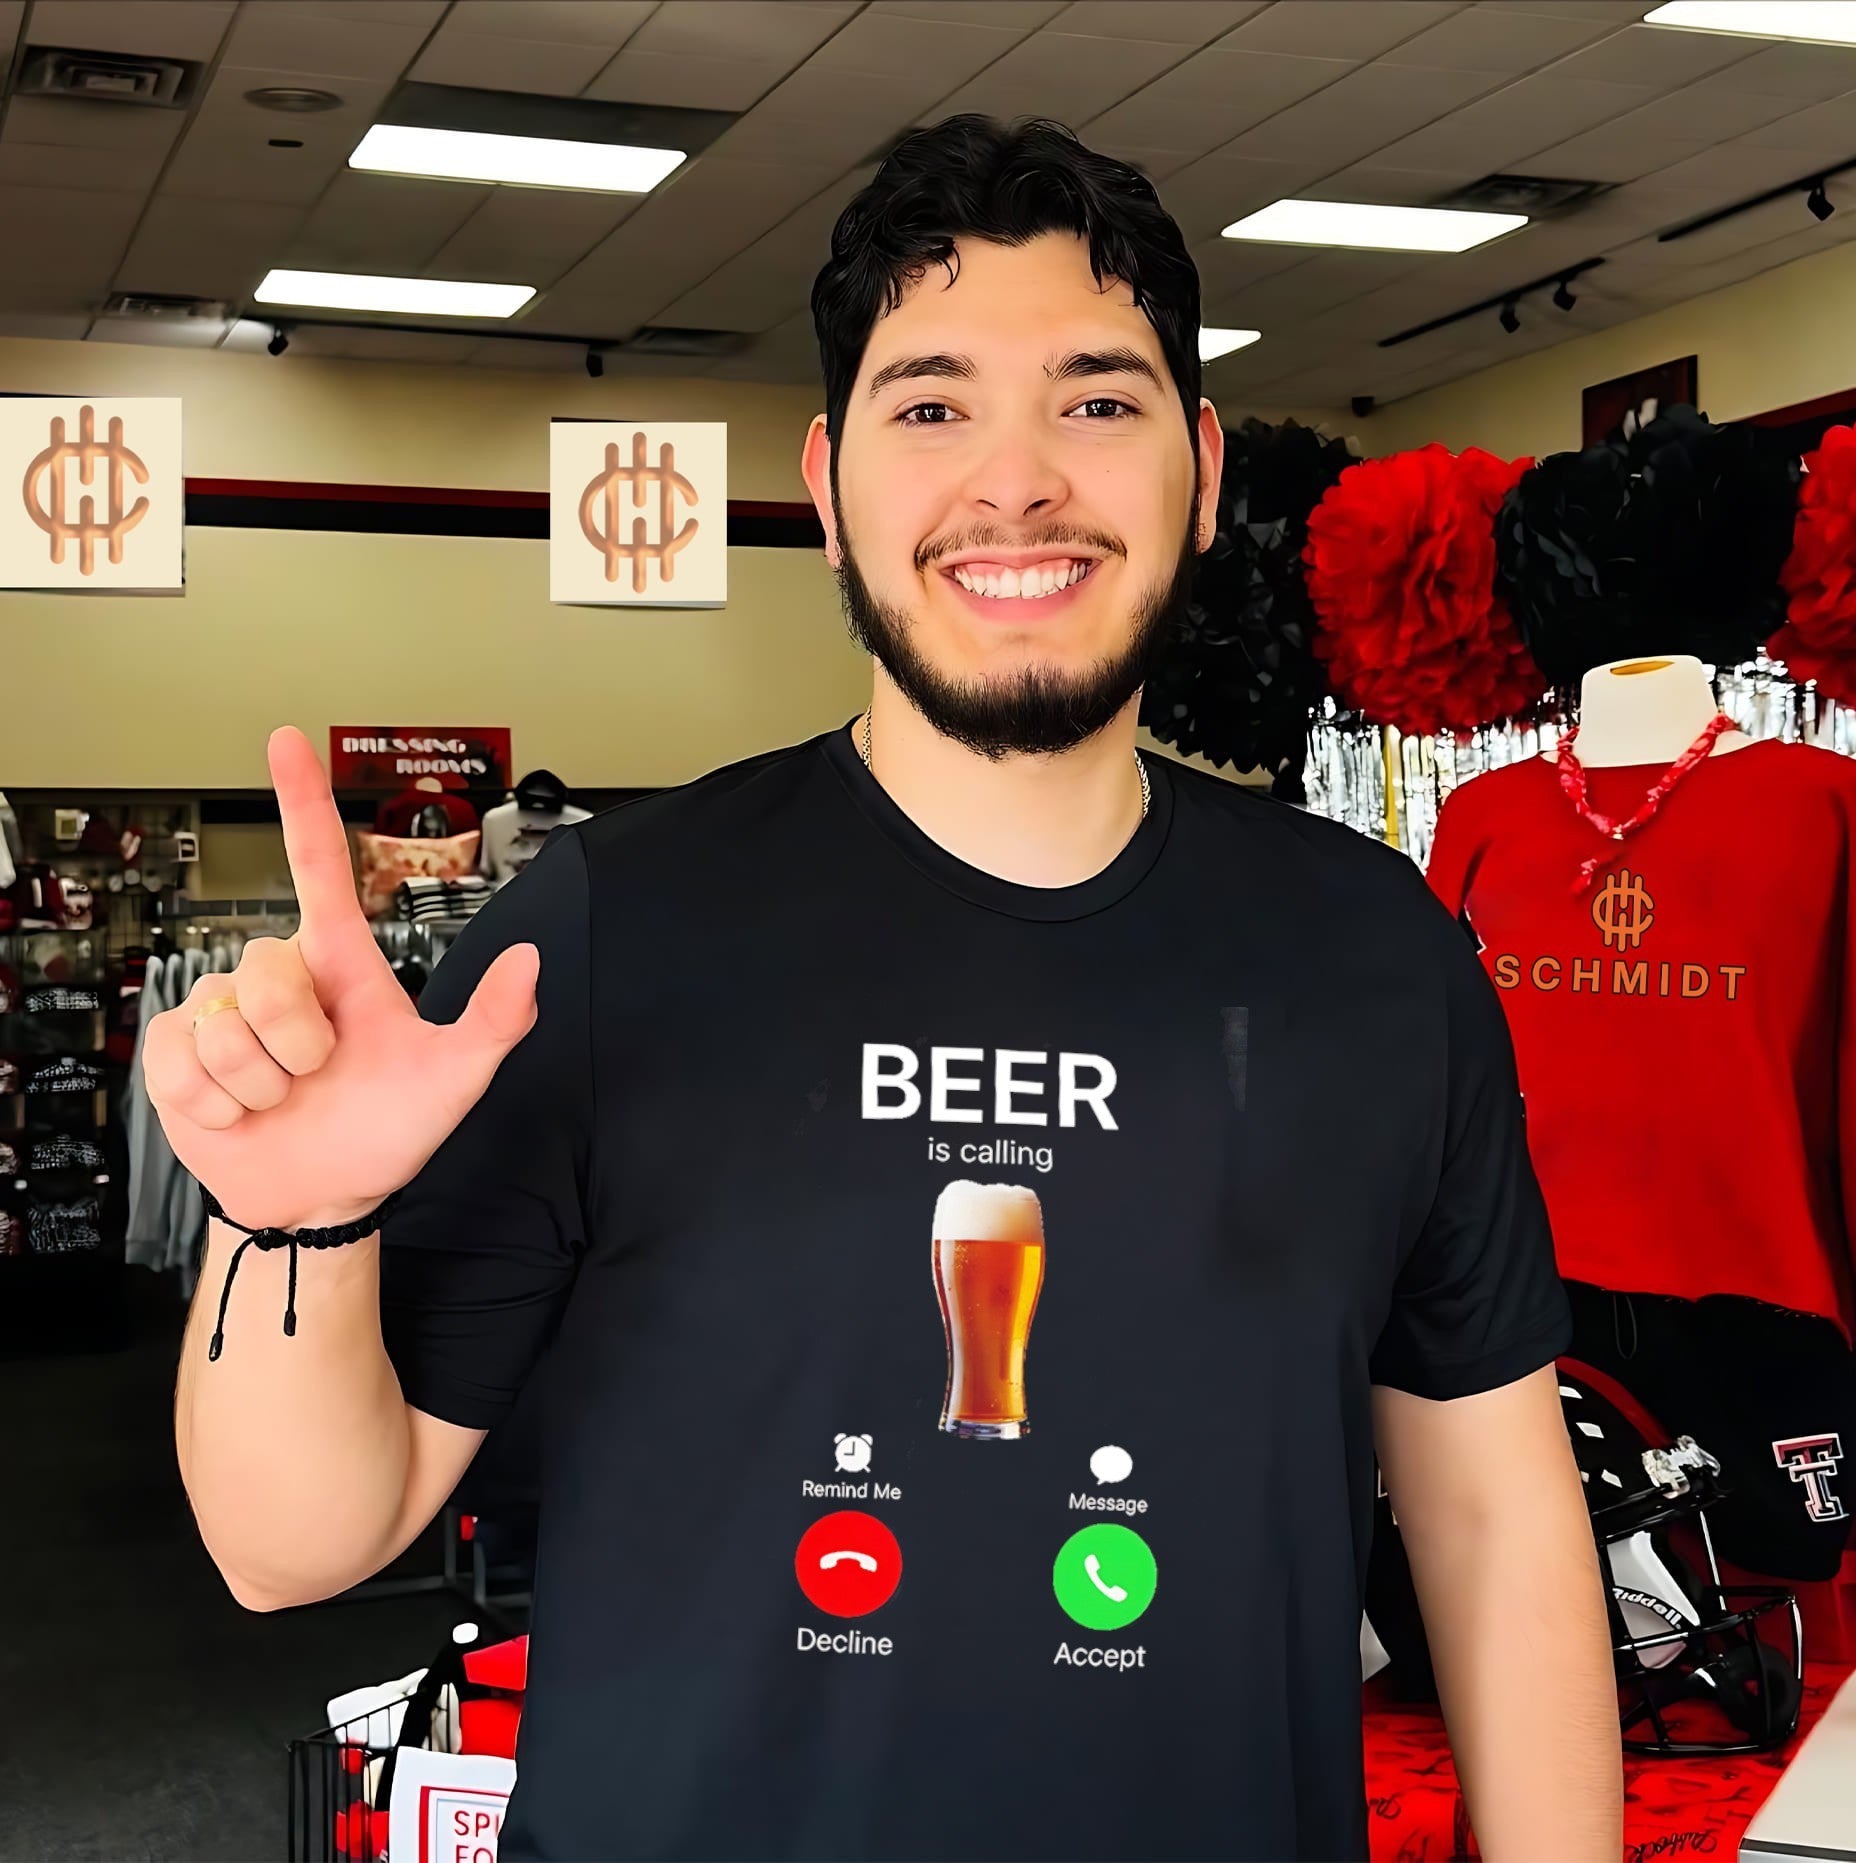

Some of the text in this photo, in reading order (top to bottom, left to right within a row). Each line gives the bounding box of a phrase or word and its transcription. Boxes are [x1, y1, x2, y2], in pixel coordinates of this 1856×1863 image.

[396, 758, 487, 775] ROOMS
[1494, 953, 1747, 1001] SCHMIDT
[861, 1042, 1120, 1131] BEER
[928, 1137, 1054, 1173] is calling
[802, 1480, 902, 1501] Remind Me
[1068, 1493, 1149, 1517] Message
[796, 1628, 894, 1656] Decline
[1053, 1642, 1147, 1673] Accept
